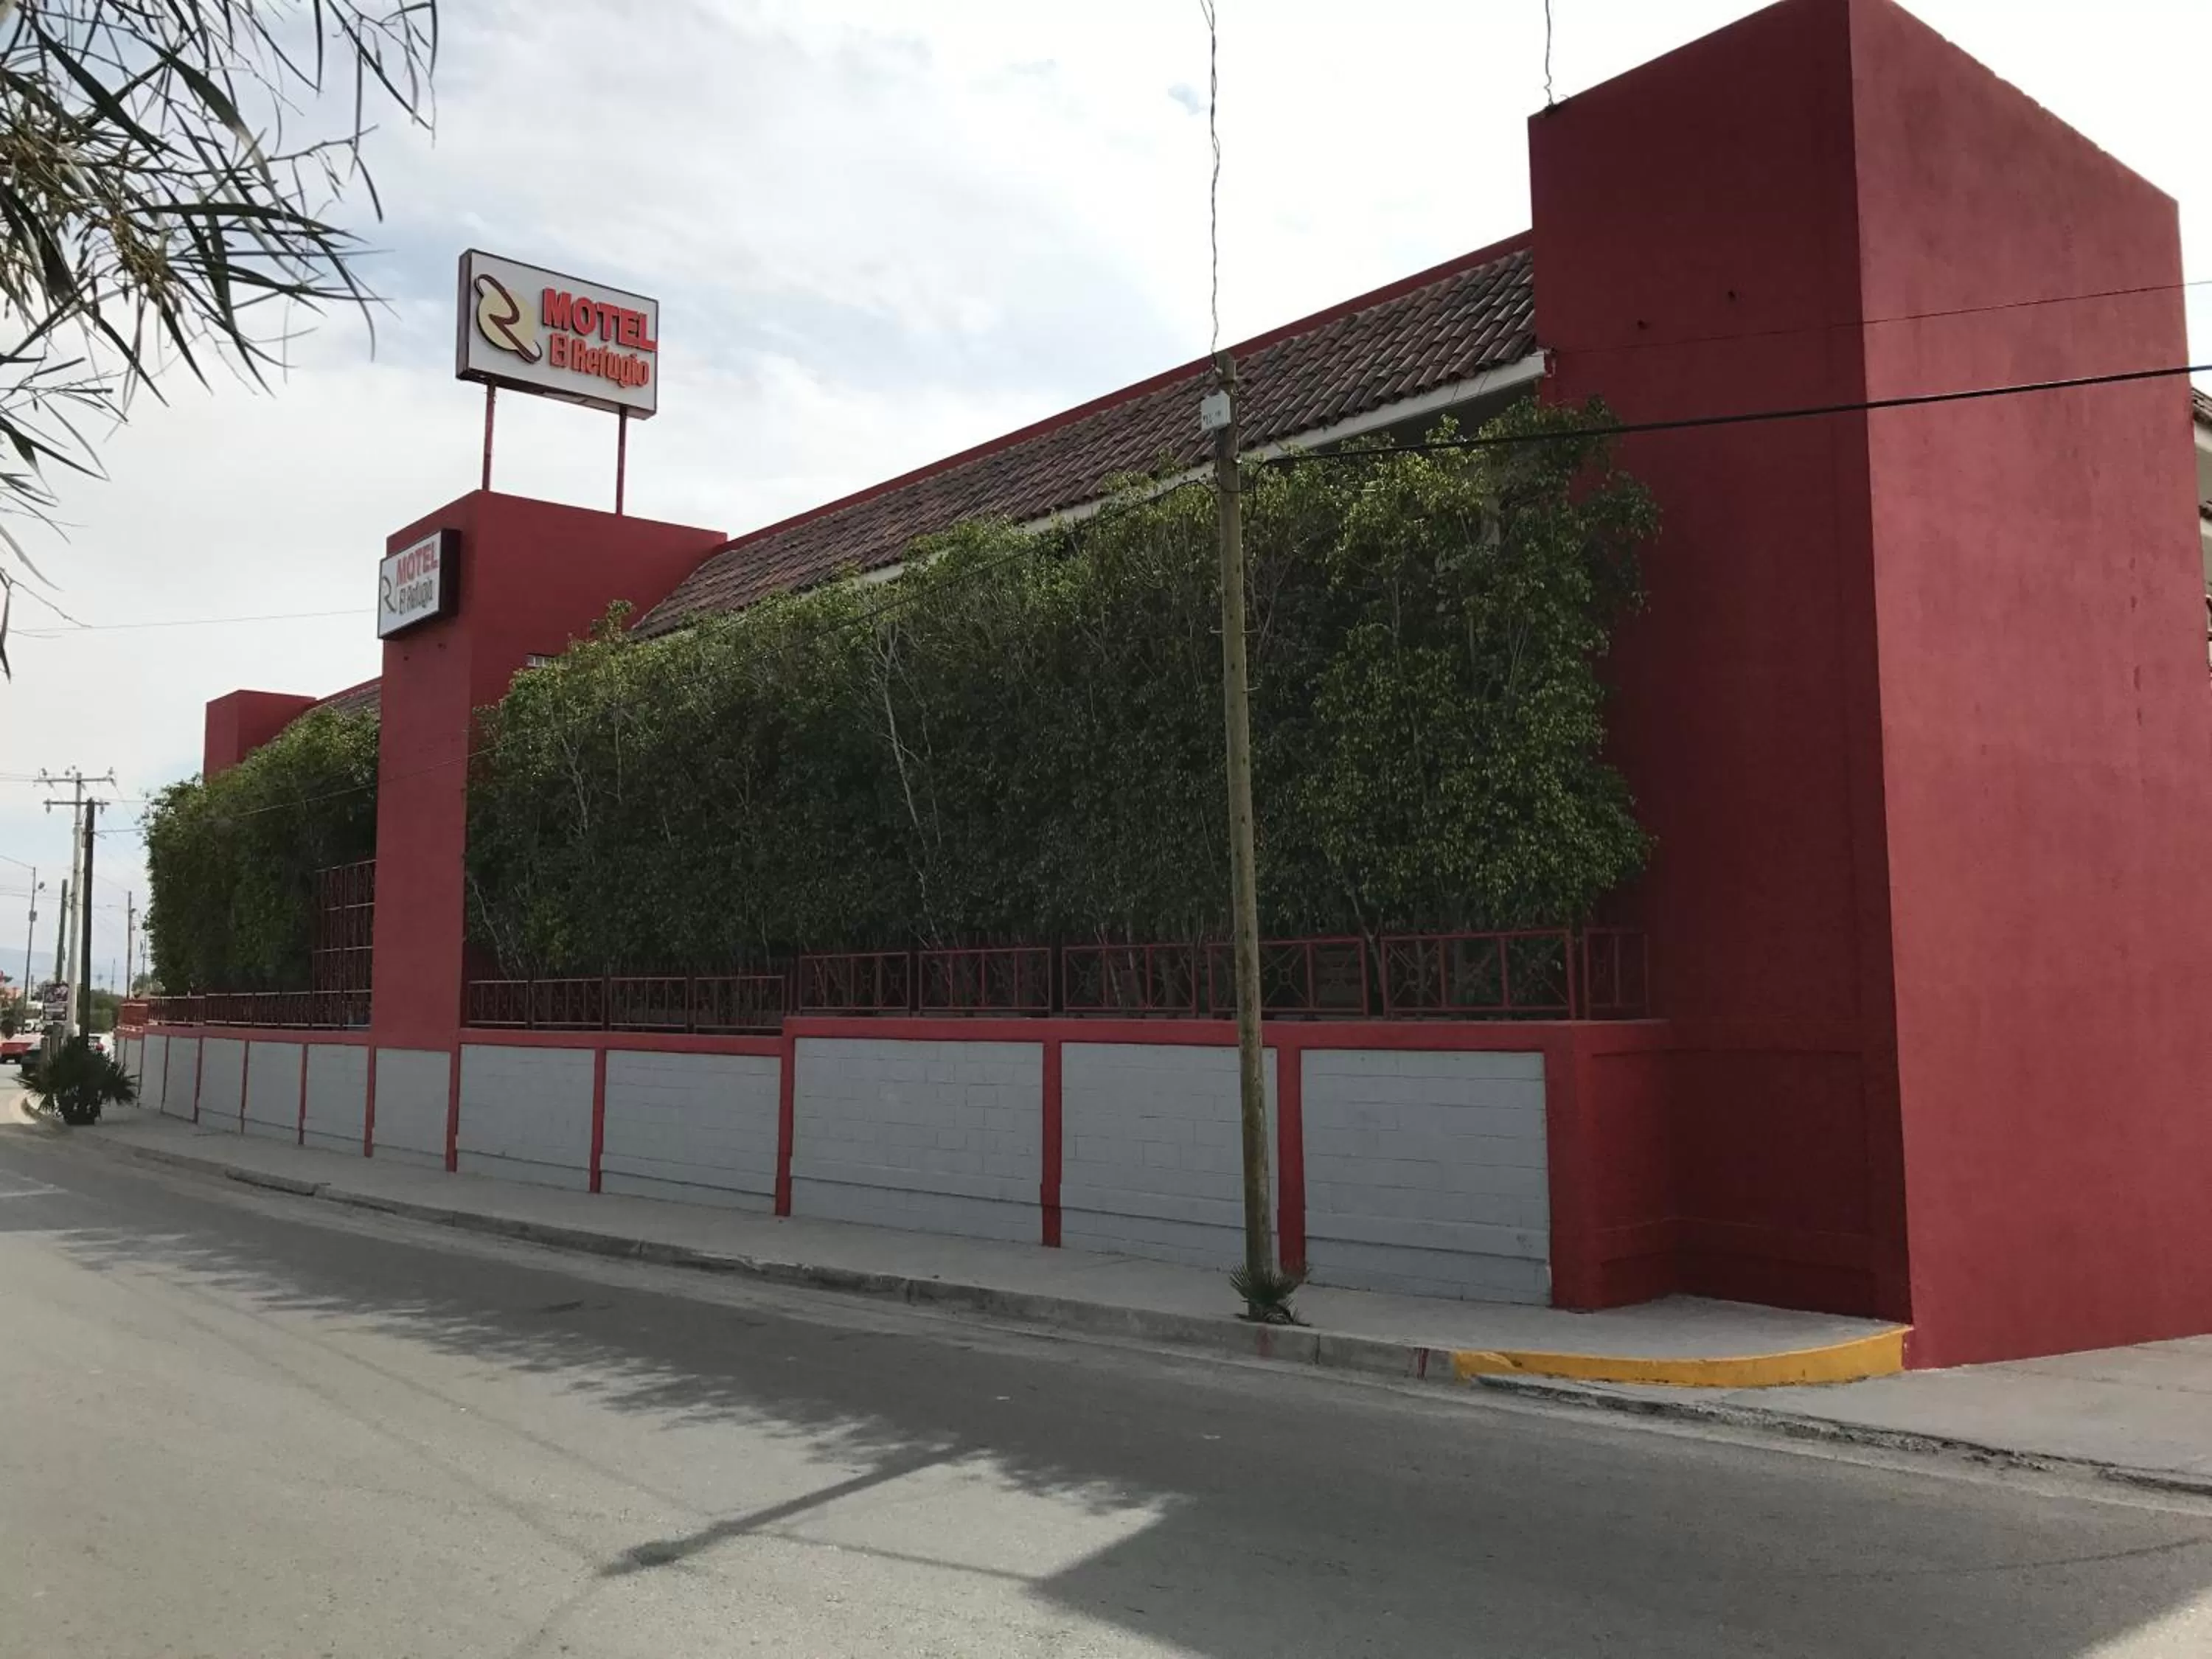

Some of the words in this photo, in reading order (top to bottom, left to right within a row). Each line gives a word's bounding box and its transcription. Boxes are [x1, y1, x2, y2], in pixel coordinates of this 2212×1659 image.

[542, 288, 658, 352] MOTEL
[549, 333, 569, 367] El
[570, 338, 649, 388] Refugio
[397, 541, 438, 585] MOTEL
